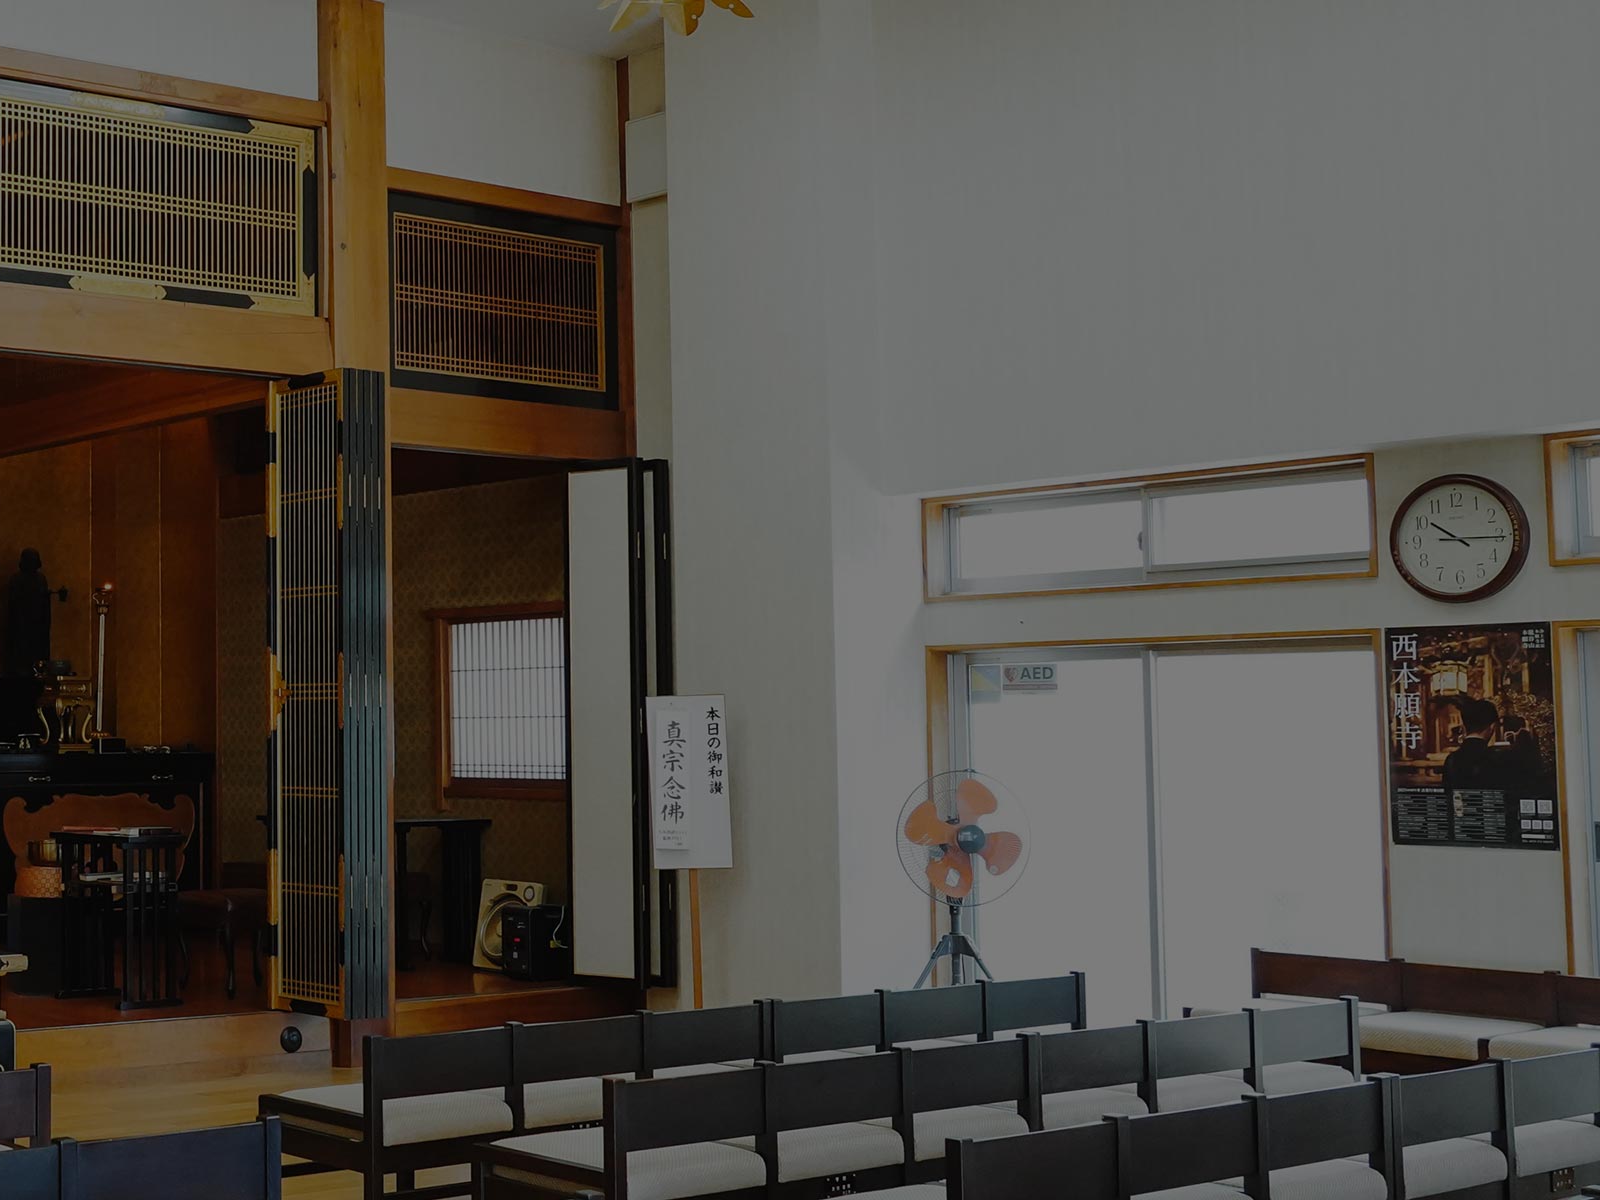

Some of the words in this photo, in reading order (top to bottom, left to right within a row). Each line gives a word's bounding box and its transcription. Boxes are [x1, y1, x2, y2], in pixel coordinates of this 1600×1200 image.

[1429, 499, 1441, 515] 11
[1449, 492, 1463, 508] 12
[1474, 495, 1479, 511] 1
[1416, 515, 1429, 531] 10
[1487, 508, 1497, 523] 2
[1412, 535, 1422, 550] 9
[1495, 527, 1505, 543] 3
[1420, 553, 1429, 568] 8
[1488, 547, 1498, 563] 4
[1436, 566, 1445, 582] 7
[1455, 569, 1466, 585] 6
[1476, 563, 1486, 579] 5
[1020, 666, 1054, 680] AED
[1390, 633, 1422, 750] 西本願寺
[661, 720, 687, 824] 真宗念佛
